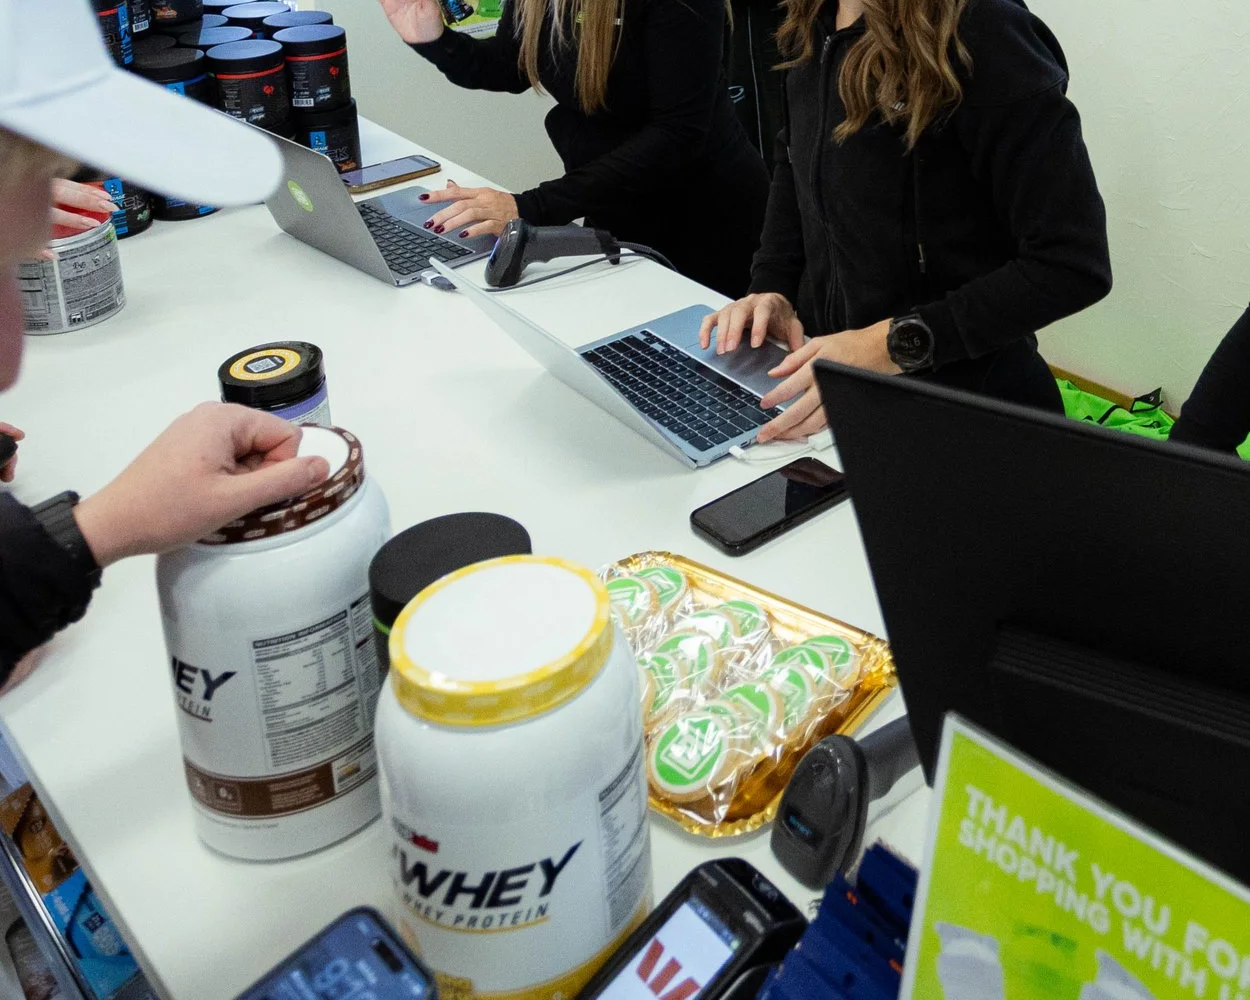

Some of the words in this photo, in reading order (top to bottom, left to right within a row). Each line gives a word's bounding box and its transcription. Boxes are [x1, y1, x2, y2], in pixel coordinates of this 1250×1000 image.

[400, 838, 585, 910] WHEY
[453, 902, 549, 930] PROTEIN
[957, 816, 1111, 937] SHOPPING
[1121, 920, 1208, 992] WITH
[964, 784, 1080, 883] THANK
[1090, 862, 1172, 937] YOU
